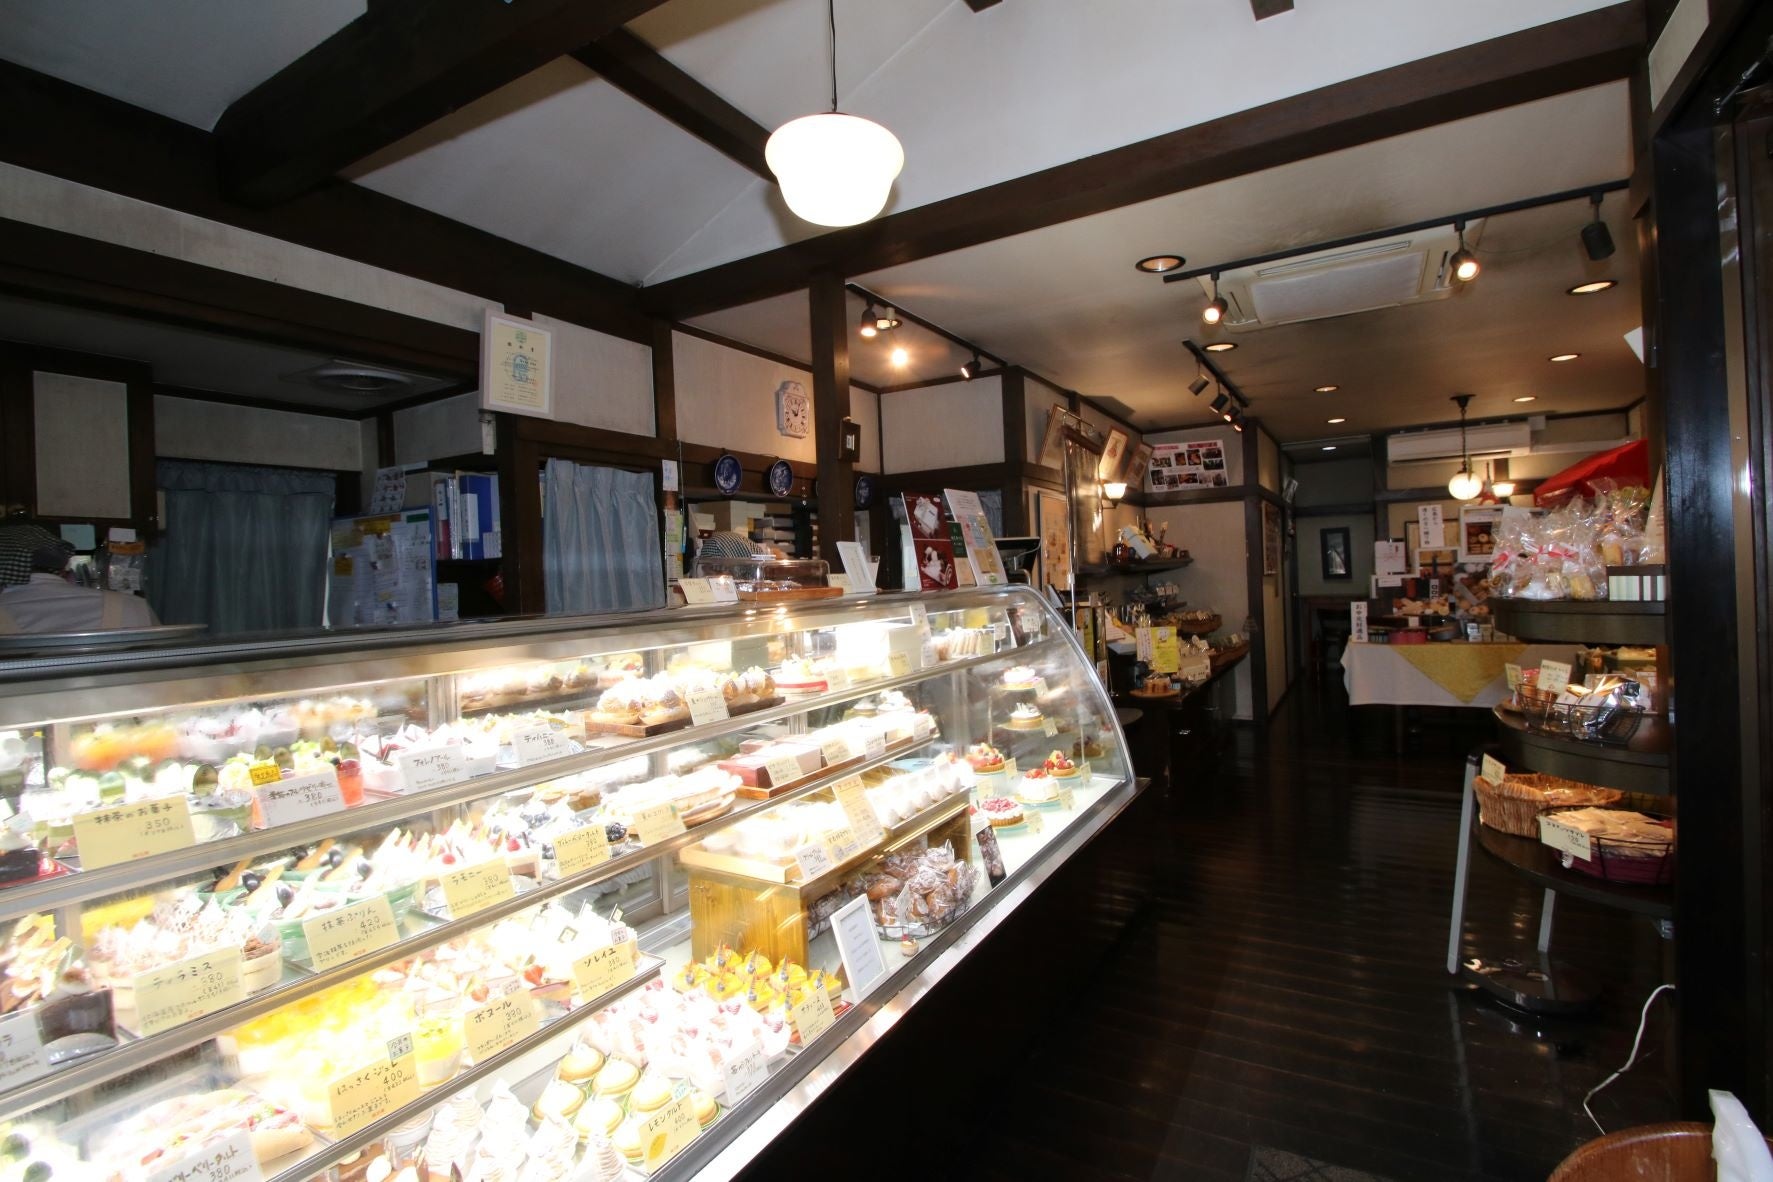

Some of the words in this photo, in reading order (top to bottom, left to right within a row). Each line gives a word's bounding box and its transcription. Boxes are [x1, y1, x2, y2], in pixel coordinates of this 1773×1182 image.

[145, 817, 171, 830] 350
[360, 915, 381, 929] 420
[152, 961, 213, 989] ティラミス
[473, 1000, 512, 1024] ボヌール
[336, 1060, 399, 1096] はっさくジュレ
[383, 1069, 403, 1085] 400
[209, 1164, 231, 1182] 380
